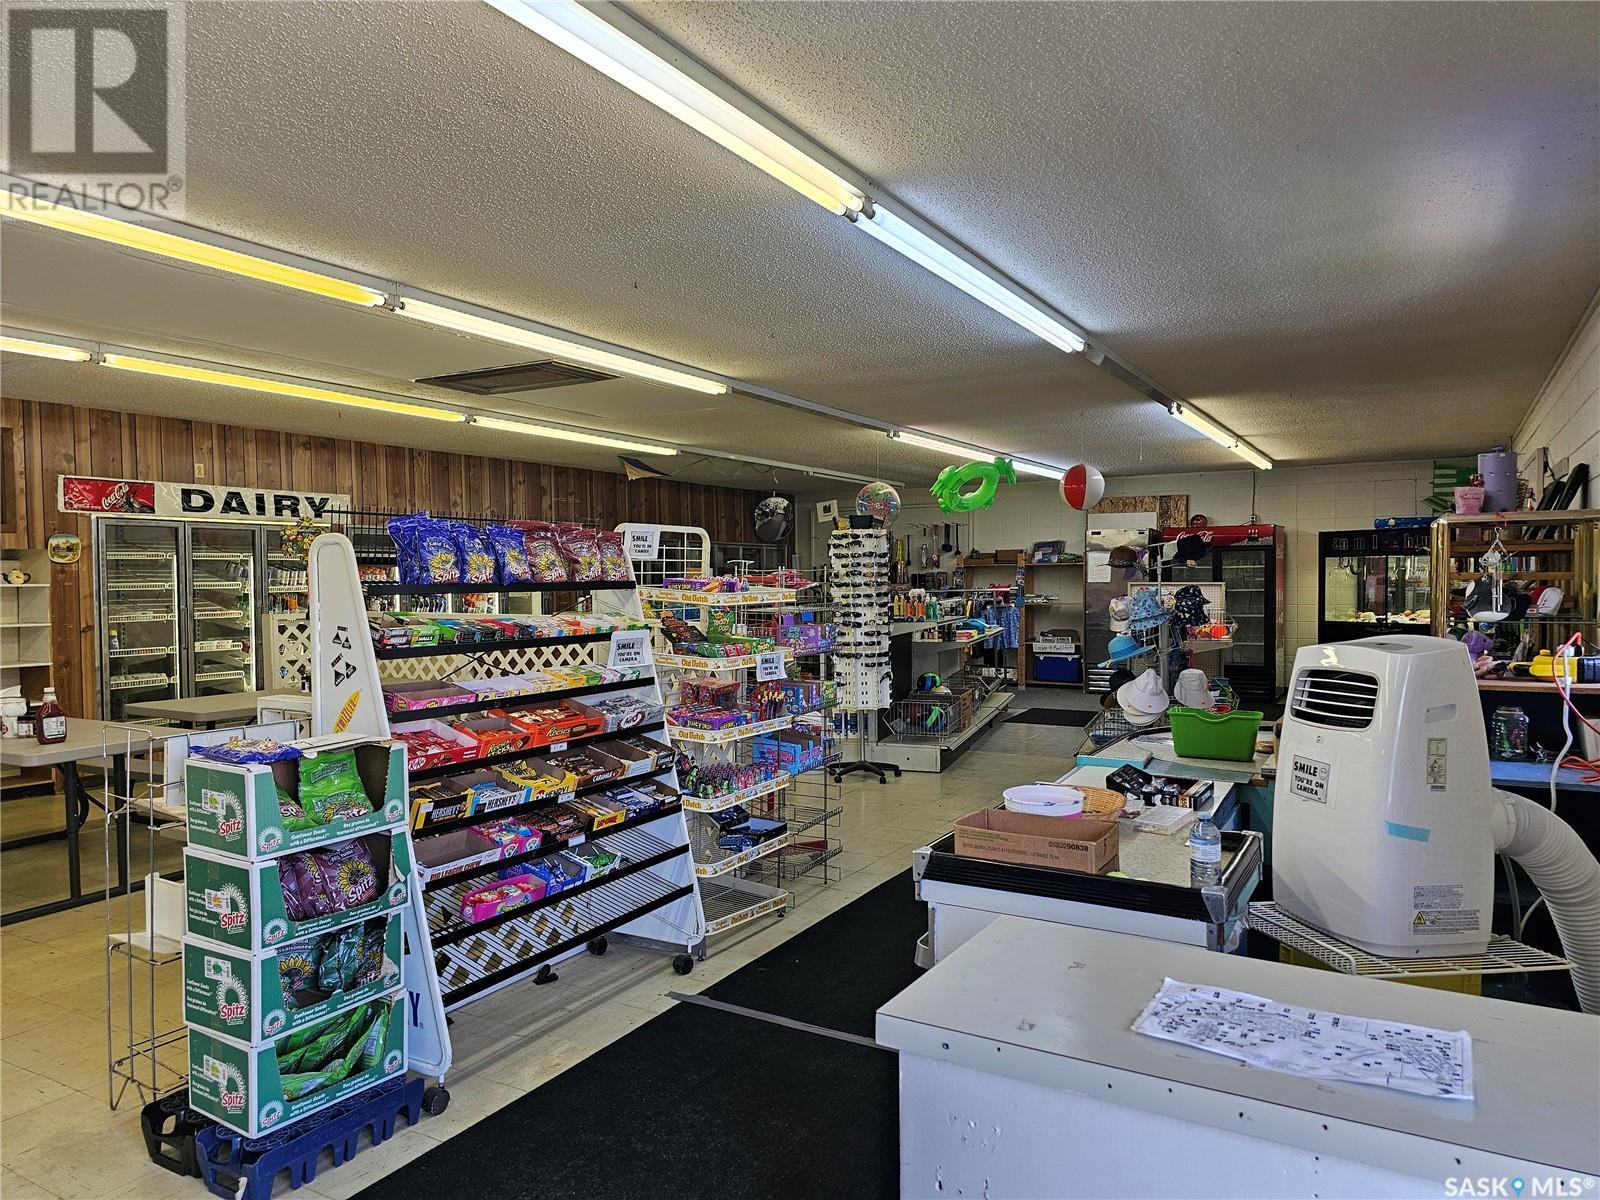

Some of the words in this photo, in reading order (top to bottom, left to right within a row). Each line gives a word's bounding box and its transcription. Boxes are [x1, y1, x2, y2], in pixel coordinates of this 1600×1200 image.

[181, 488, 331, 518] DAIRY
[682, 593, 692, 602] Old
[693, 594, 708, 603] Dutch
[682, 658, 692, 668] Old
[693, 659, 708, 668] Dutch
[679, 730, 688, 739] Old
[689, 732, 705, 740] Dutch
[1294, 761, 1318, 777] SMILE
[1294, 775, 1313, 786] YOU'RE
[1315, 781, 1324, 790] ON
[535, 792, 546, 801] OH
[1297, 784, 1318, 796] CAMERA
[486, 795, 517, 810] HERSHEY'S
[686, 800, 702, 808] Dutch
[432, 804, 461, 819] HERSHEY'S
[220, 819, 242, 836] Spitz
[260, 838, 280, 852] Spitz
[348, 876, 374, 902] Spitz
[222, 913, 245, 928] Spitz
[266, 930, 285, 943] Spitz
[220, 1004, 245, 1019] Spitz
[265, 1020, 284, 1034] Spitz
[222, 1093, 244, 1106] Spitz
[262, 1111, 280, 1126] Spitz
